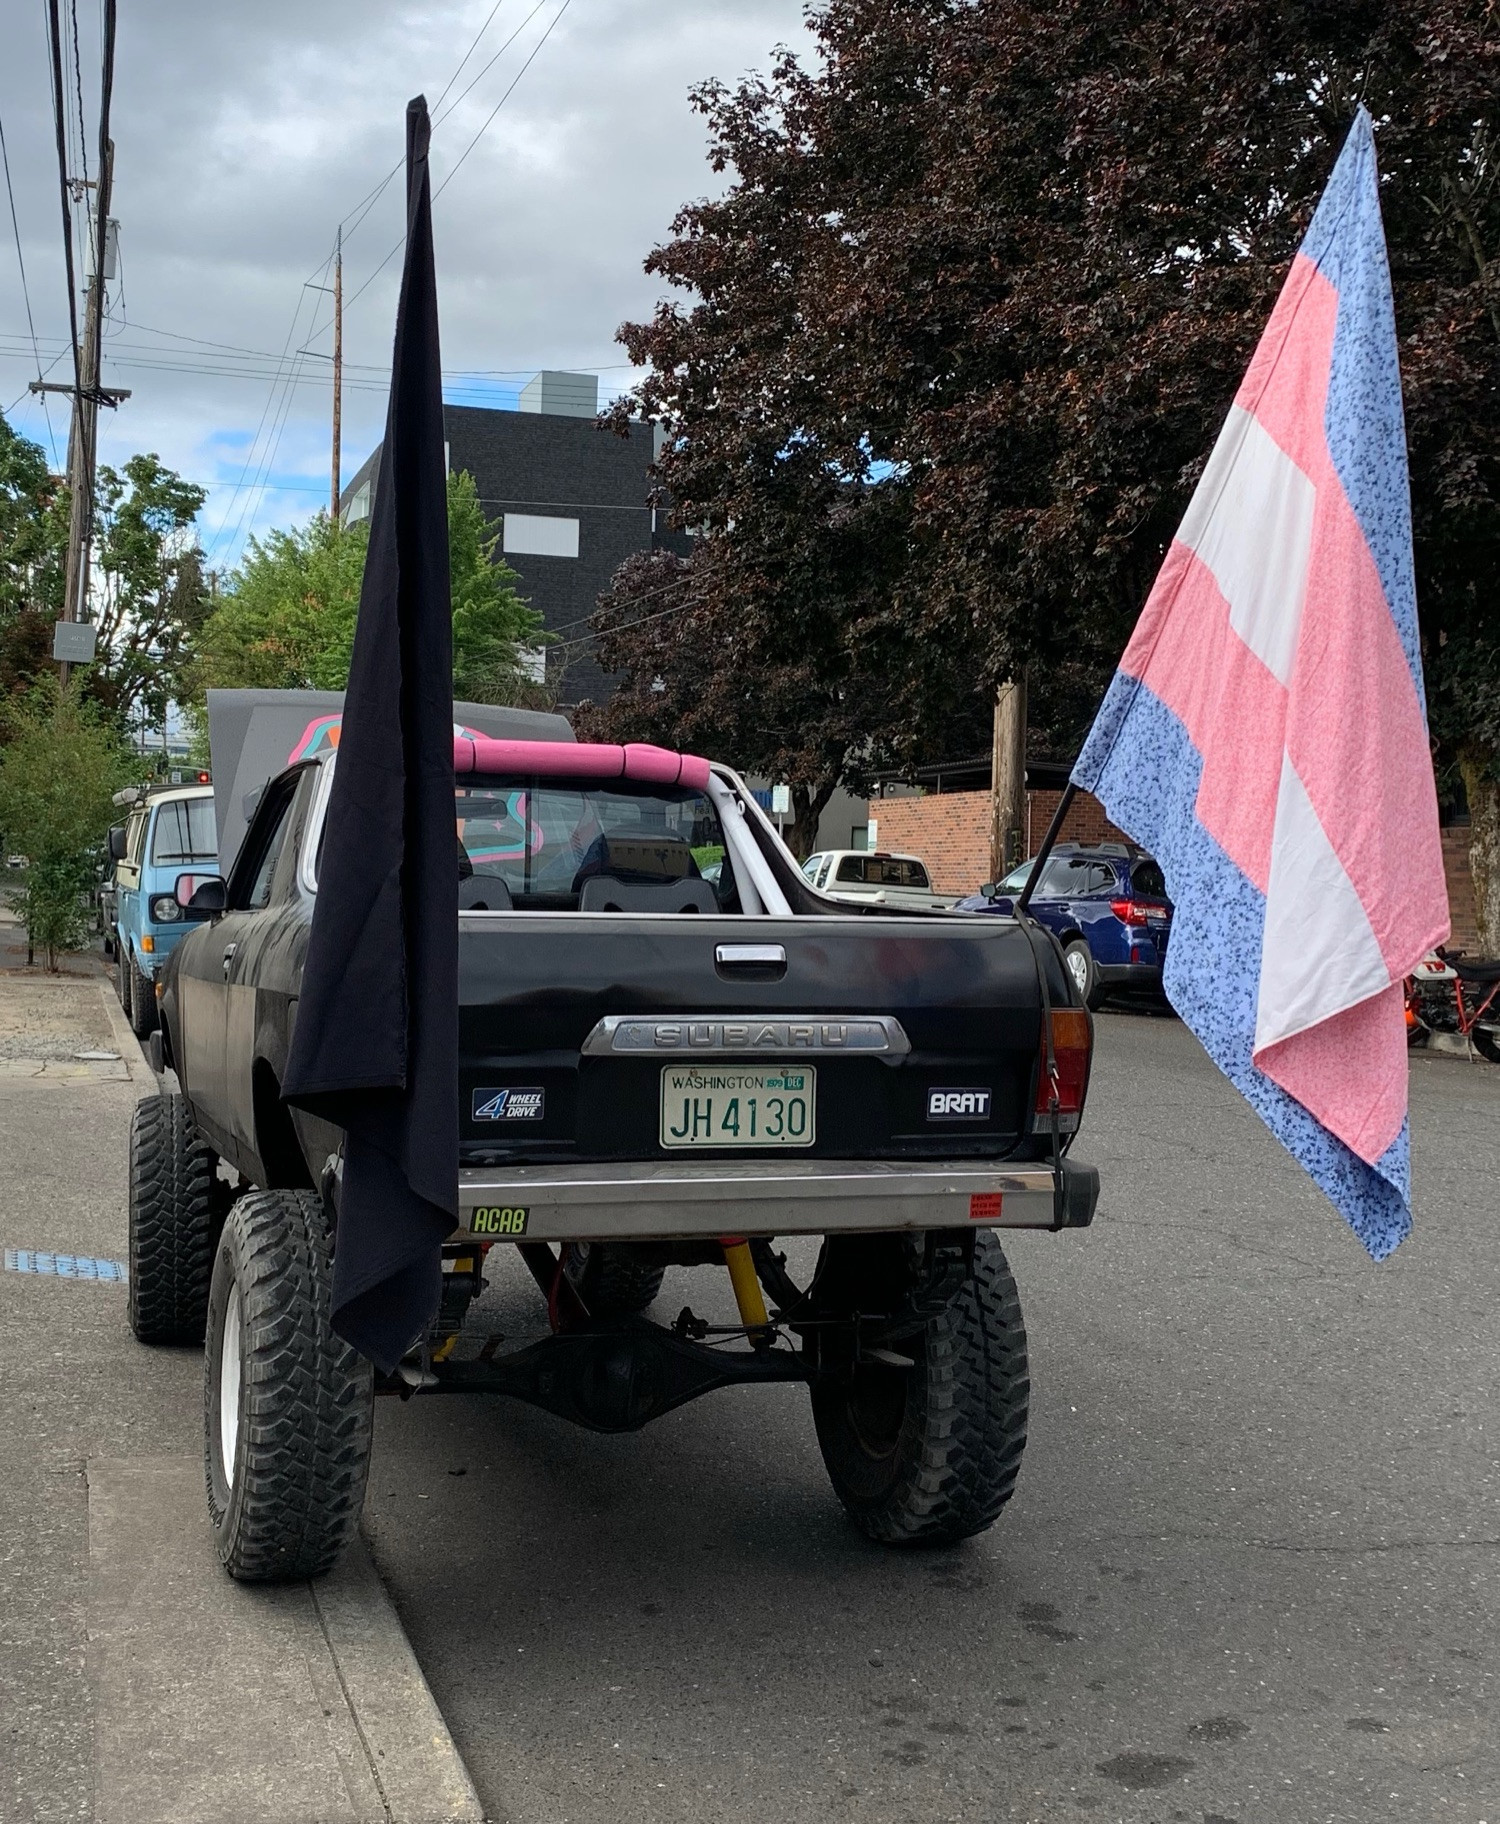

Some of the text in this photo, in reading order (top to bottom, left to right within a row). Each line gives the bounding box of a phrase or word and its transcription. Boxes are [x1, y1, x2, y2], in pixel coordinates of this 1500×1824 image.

[654, 1024, 847, 1047] SUBARU
[672, 1076, 764, 1089] WASHINGTON
[787, 1077, 802, 1087] DEC
[475, 1089, 541, 1119] 4 WHEEL
[506, 1106, 537, 1117] DRIVE
[930, 1093, 989, 1113] BRAT
[670, 1098, 806, 1137] JH 4130
[474, 1207, 525, 1233] ACAB
